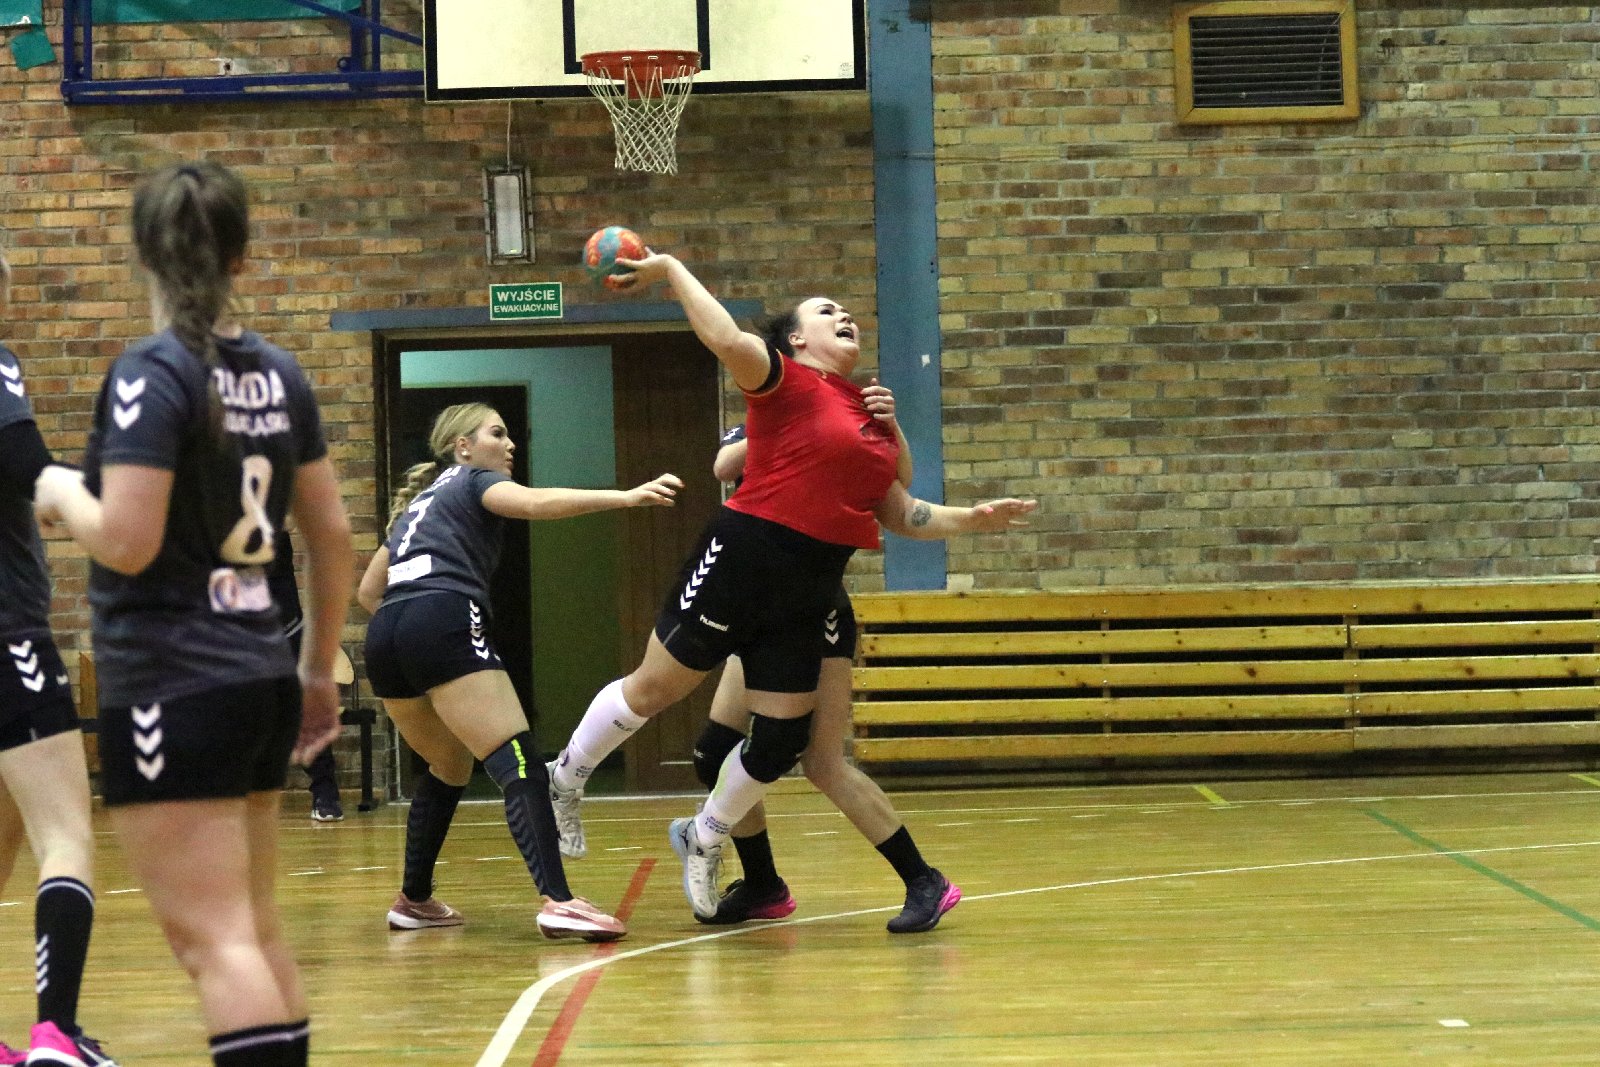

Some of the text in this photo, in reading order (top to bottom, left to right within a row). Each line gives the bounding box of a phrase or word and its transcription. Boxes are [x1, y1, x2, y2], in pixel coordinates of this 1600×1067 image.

[496, 288, 556, 302] WYJŚCIE
[494, 303, 559, 313] EWAKUACYJNE
[219, 455, 276, 565] 8
[397, 495, 434, 557] 7
[699, 614, 729, 631] hummel
